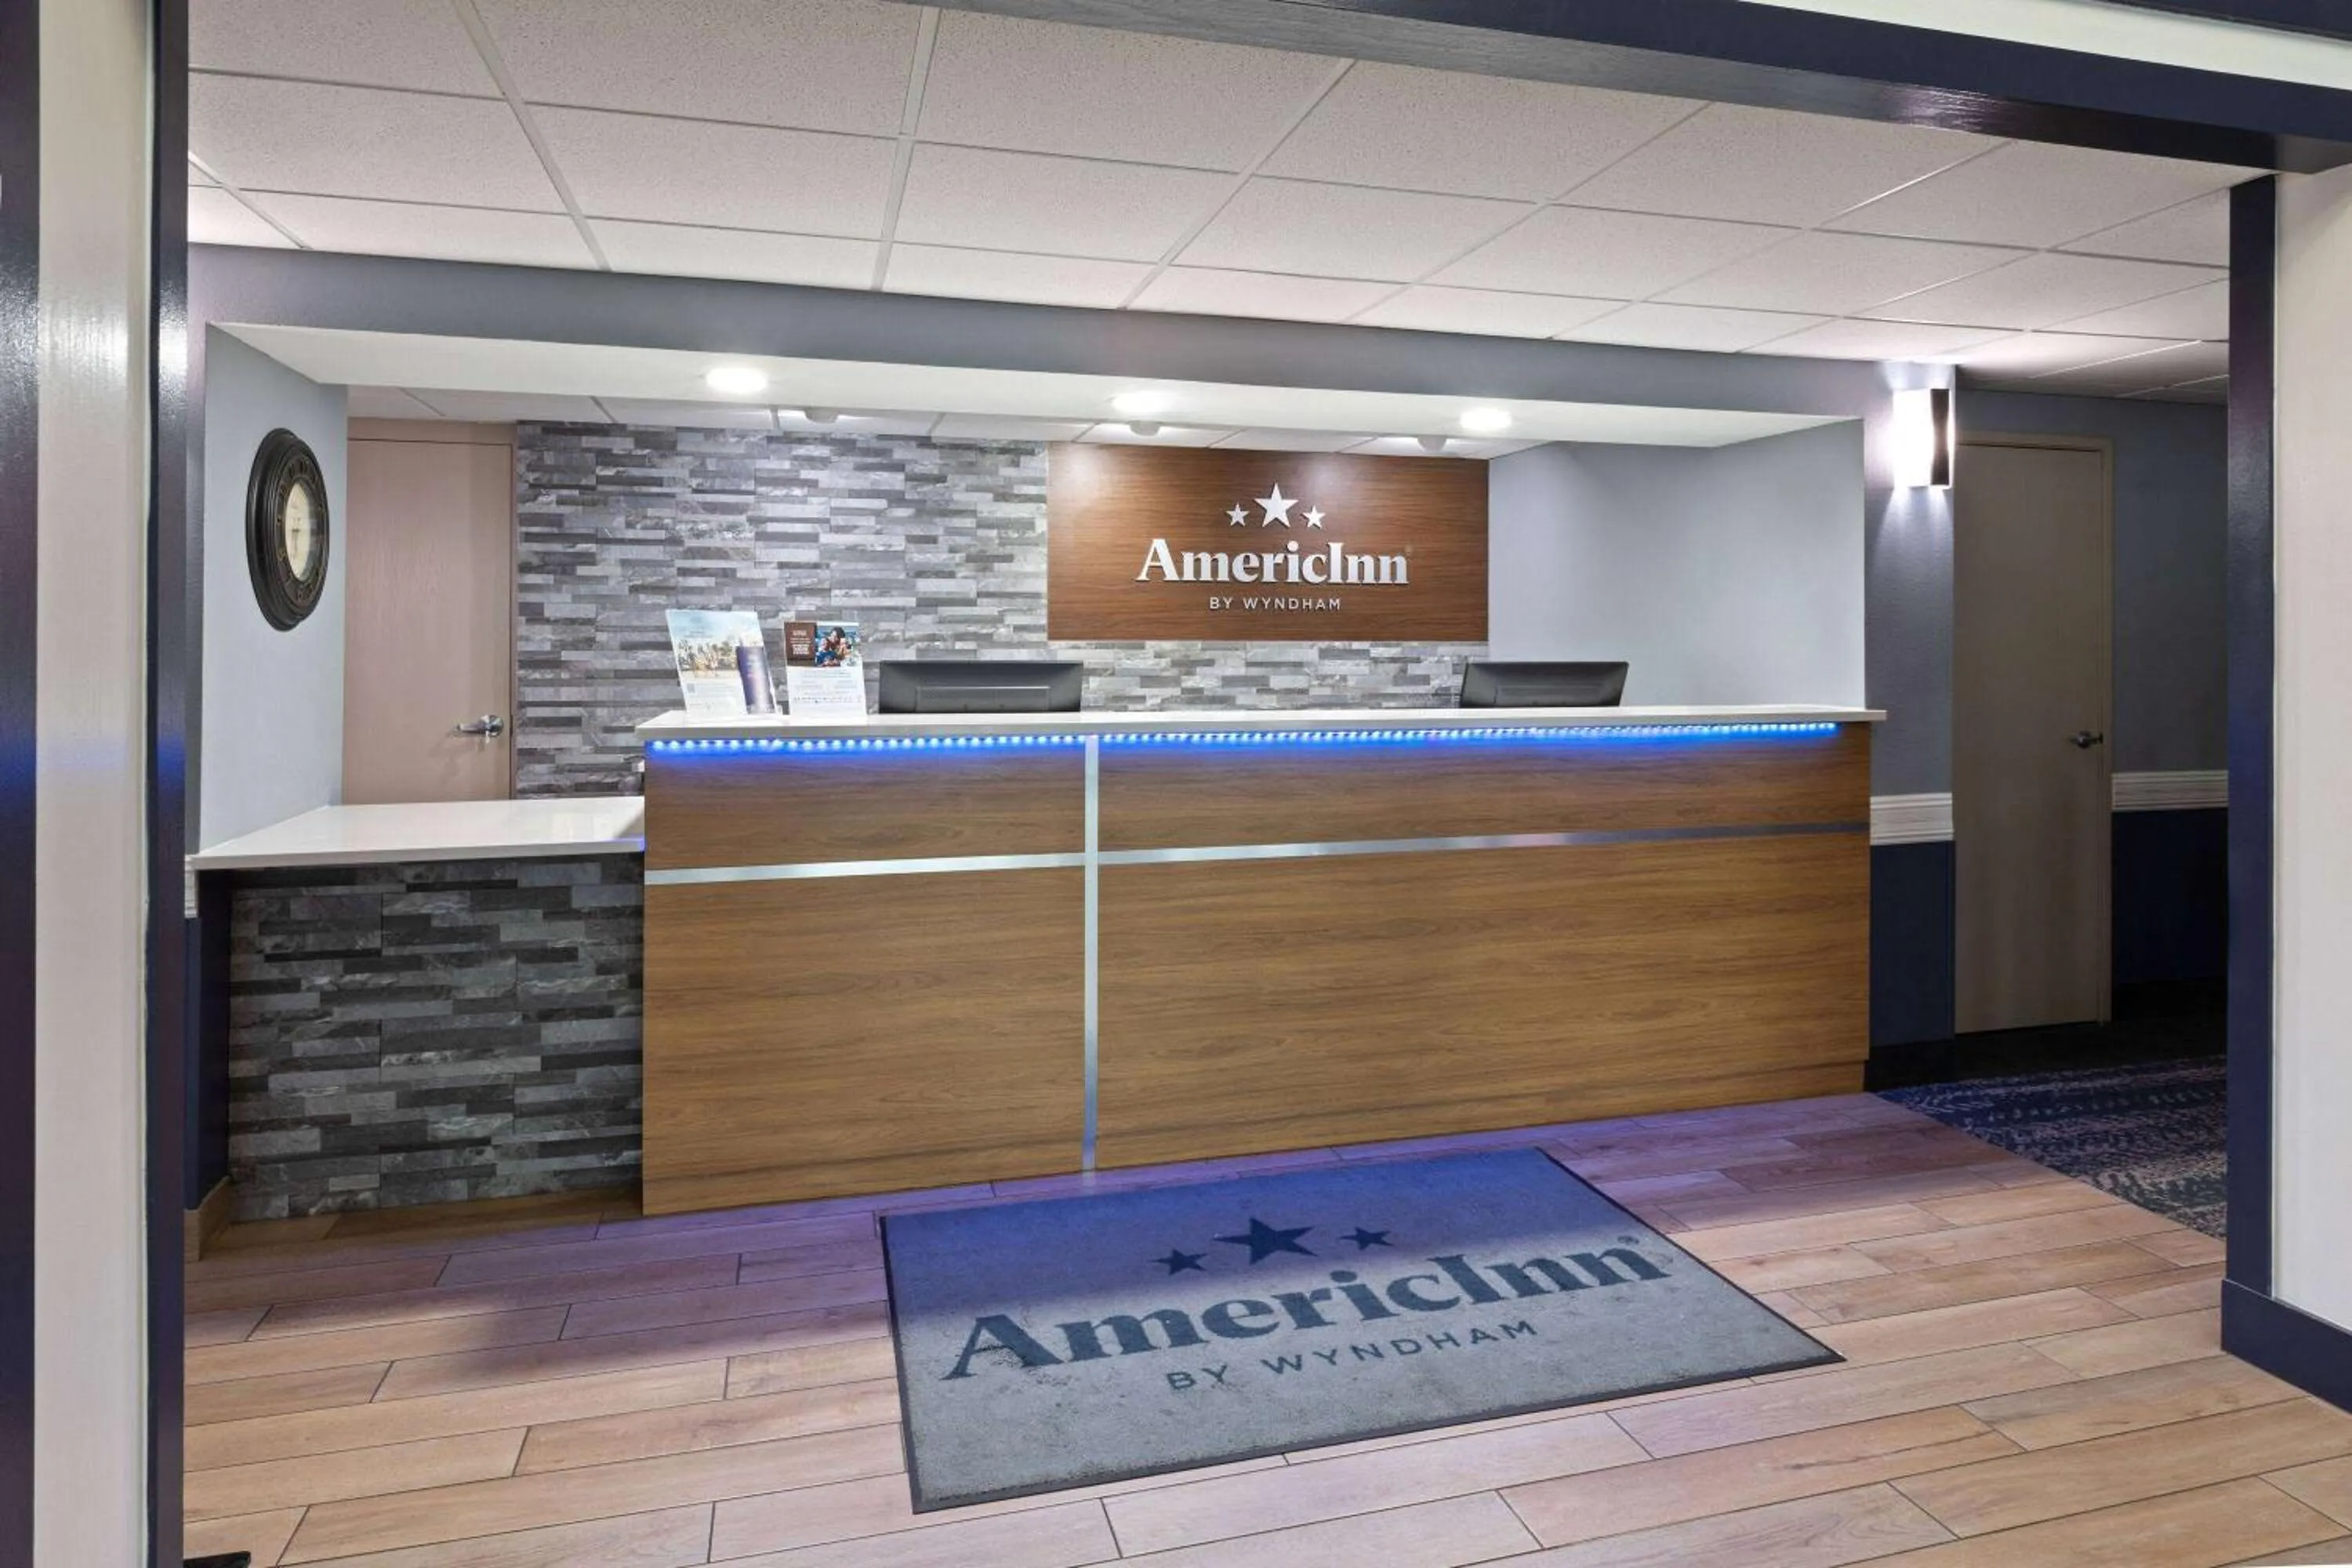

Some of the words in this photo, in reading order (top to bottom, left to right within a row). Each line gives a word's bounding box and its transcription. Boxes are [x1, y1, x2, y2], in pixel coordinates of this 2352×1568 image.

[1134, 538, 1410, 585] AmericInn
[1209, 597, 1233, 610] BY
[1243, 597, 1341, 611] WYNDHAM
[1165, 1363, 1229, 1392] BY
[1261, 1319, 1538, 1375] WYNDHAM
